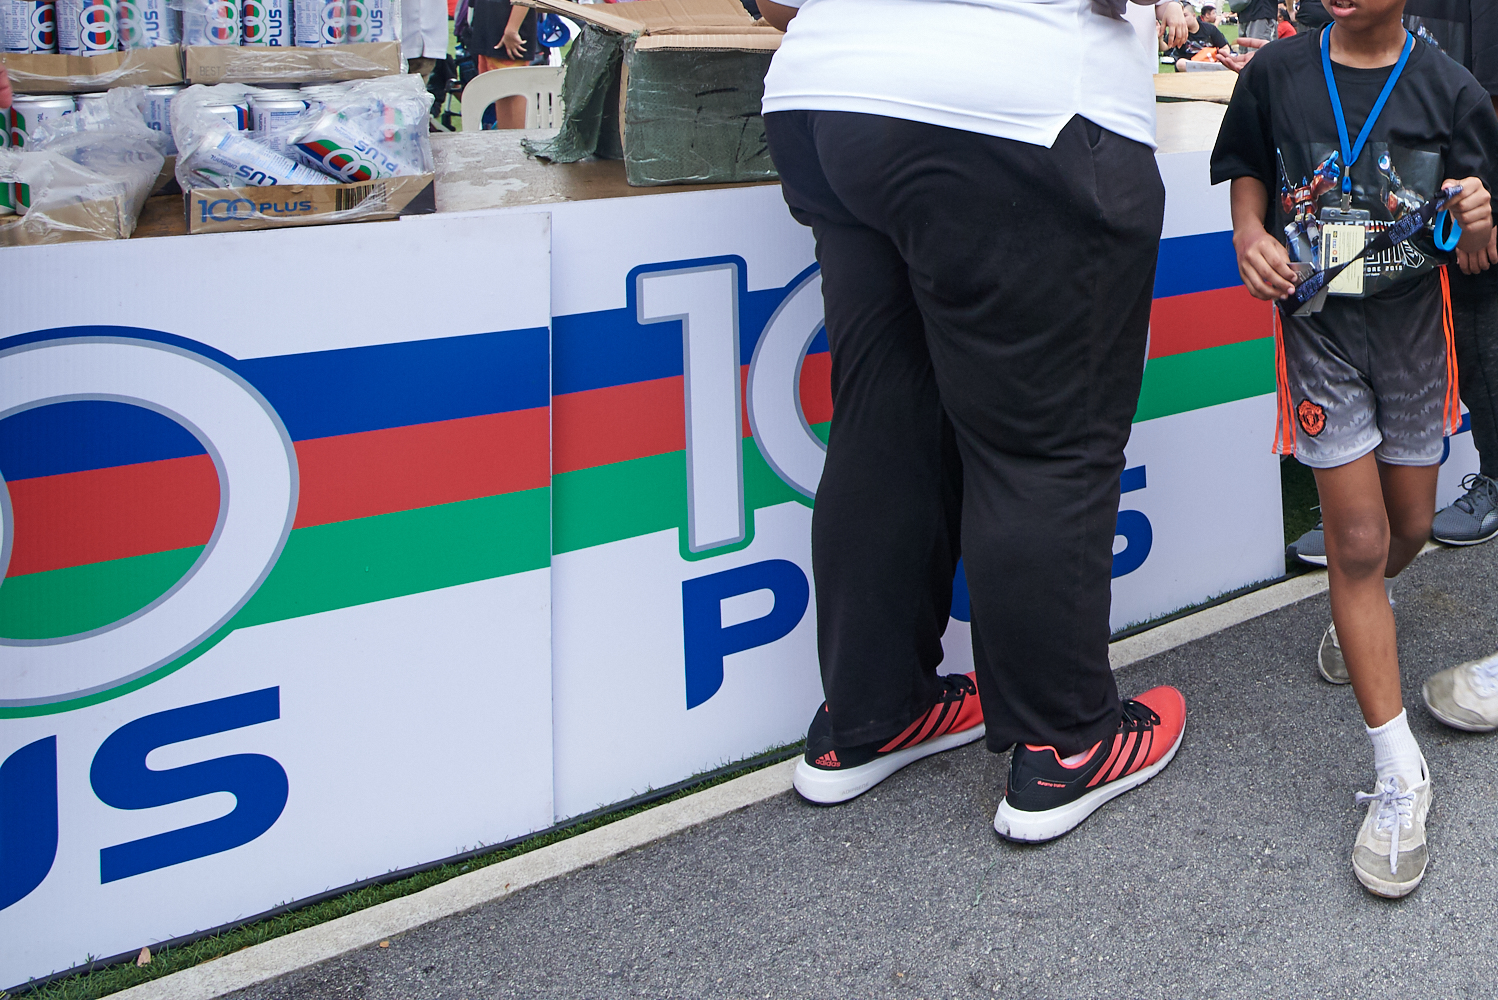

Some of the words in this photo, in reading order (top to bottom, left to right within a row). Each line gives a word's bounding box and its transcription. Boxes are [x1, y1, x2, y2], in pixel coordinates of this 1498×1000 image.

[30, 3, 56, 54] 00
[79, 4, 117, 57] 00
[204, 1, 239, 47] 00
[243, 0, 267, 47] 00
[268, 9, 283, 47] PLUS
[321, 1, 346, 48] 00
[347, 0, 369, 43] 00
[199, 65, 221, 77] BEST
[235, 164, 278, 186] LUS
[353, 139, 398, 174] PLUS
[198, 198, 257, 223] 100
[259, 200, 312, 214] PLUS
[815, 758, 841, 768] adidas
